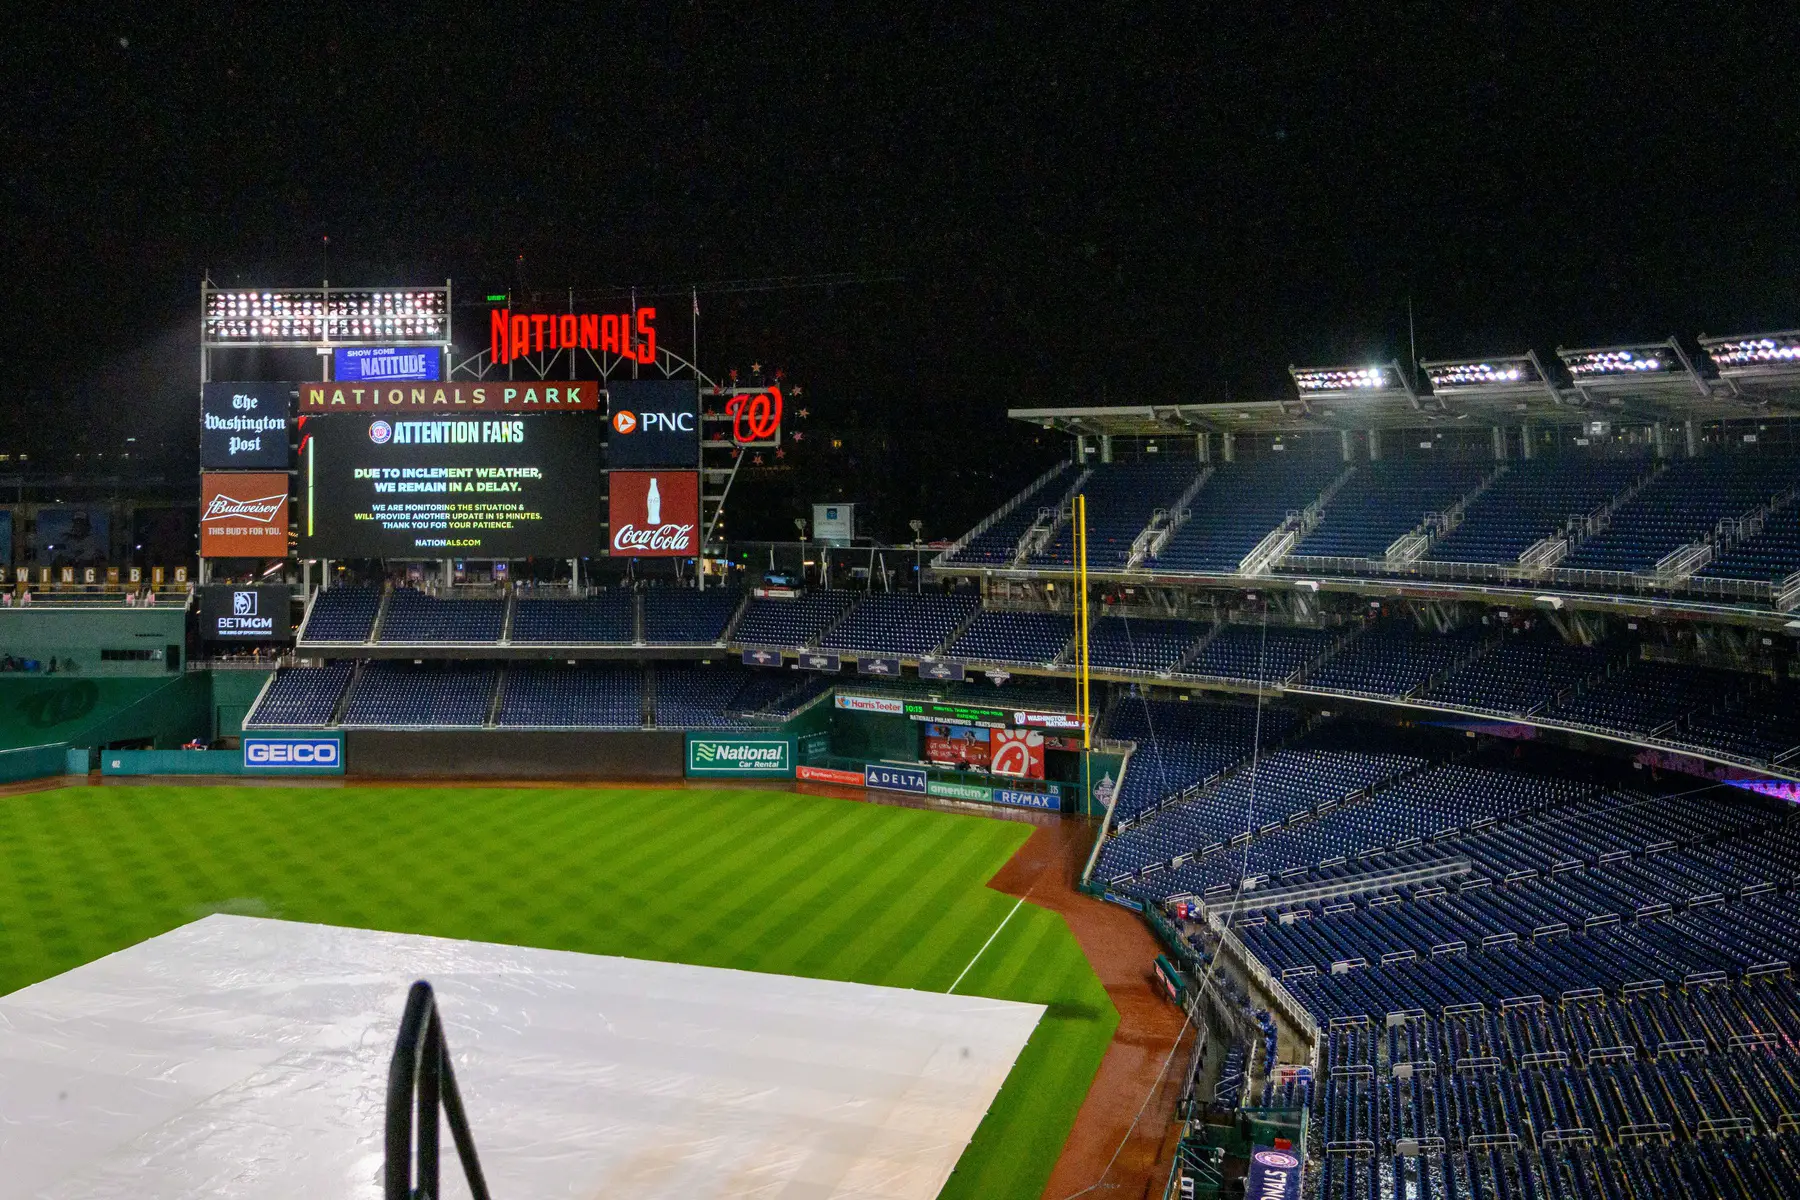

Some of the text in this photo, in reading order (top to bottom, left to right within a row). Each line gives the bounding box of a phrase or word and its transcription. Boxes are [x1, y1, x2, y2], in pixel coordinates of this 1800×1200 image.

[491, 308, 656, 364] NATIONALS
[347, 347, 395, 357] SHOW SOME
[361, 354, 426, 377] NATITUDE
[232, 394, 258, 411] The
[309, 387, 581, 405] NATIONALS PARK
[725, 385, 783, 442] W
[205, 413, 286, 433] Washington
[641, 412, 694, 432] PNC
[393, 421, 524, 443] ATTENTION FANS
[229, 436, 261, 455] Post
[354, 468, 542, 479] DUE TO INCLEMENT WEATHER,
[375, 482, 522, 492] WE REMAIN IN A DELAY.
[209, 501, 278, 514] Budweiser
[372, 504, 525, 512] WE ARE MONITORING THE SITUATION &
[208, 527, 281, 536] THIS BUD'S FOR YOU.
[614, 524, 694, 550] Coca-Cola
[130, 567, 186, 582] BIG
[218, 617, 272, 628] BETMGM
[851, 699, 901, 712] Harris Teeter
[248, 743, 336, 762] GEICO
[716, 745, 782, 760] National
[882, 772, 924, 787] DELTA
[930, 785, 981, 798] amentum
[1050, 785, 1058, 795] 335
[1002, 791, 1049, 808] RE/MAX
